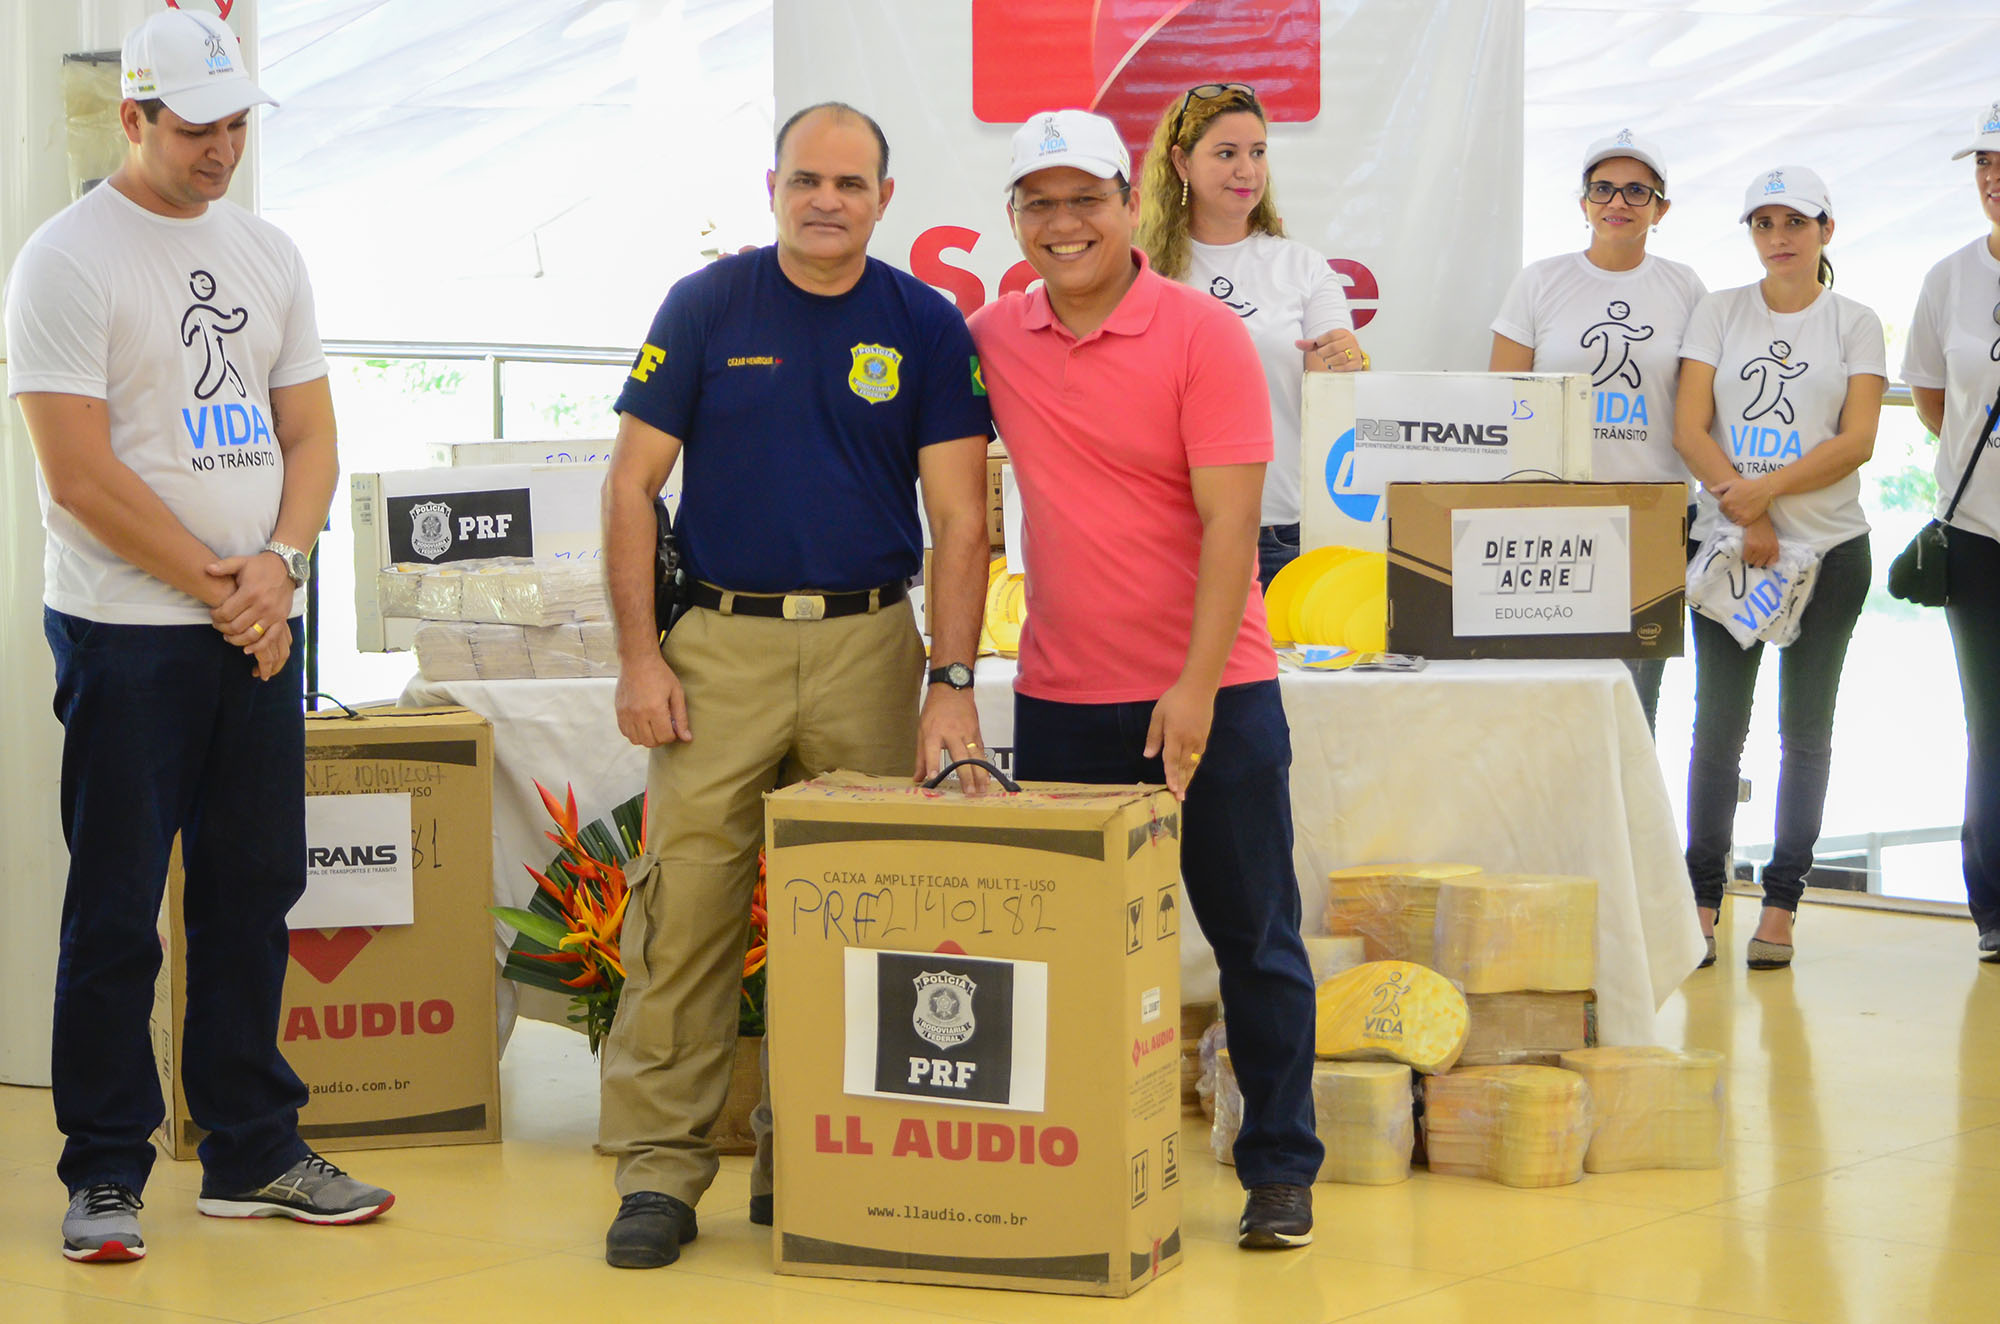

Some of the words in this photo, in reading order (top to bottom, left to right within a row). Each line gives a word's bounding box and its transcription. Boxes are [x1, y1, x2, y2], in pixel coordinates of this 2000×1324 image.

[1040, 137, 1067, 151] VIDA
[1591, 391, 1649, 426] IDA
[182, 403, 272, 449] VIDA
[1355, 418, 1509, 447] RBTRANS
[1593, 425, 1648, 442] TRÂNSITO
[1730, 424, 1803, 459] VIDA
[192, 456, 215, 471] NO
[217, 448, 275, 469] TRÂNSITO
[458, 514, 513, 541] PRF
[1485, 539, 1593, 559] DETRAN
[1501, 568, 1571, 588] ACRE
[1495, 604, 1574, 621] EDUCAÇÃO
[307, 844, 398, 868] RANS
[823, 871, 867, 884] CAIXA
[874, 873, 970, 889] AMPLIFICADA
[977, 877, 1056, 893] MULTI-USO
[283, 998, 455, 1042] AUDIO
[1365, 1016, 1403, 1035] VIDA
[1151, 1026, 1174, 1052] AUDIO
[908, 1056, 976, 1089] PRF
[306, 1078, 411, 1095] laudio.com.br
[815, 1114, 873, 1156] LL
[891, 1118, 1079, 1168] AUDIO
[867, 1204, 1029, 1227] www.llaudio.com.br
